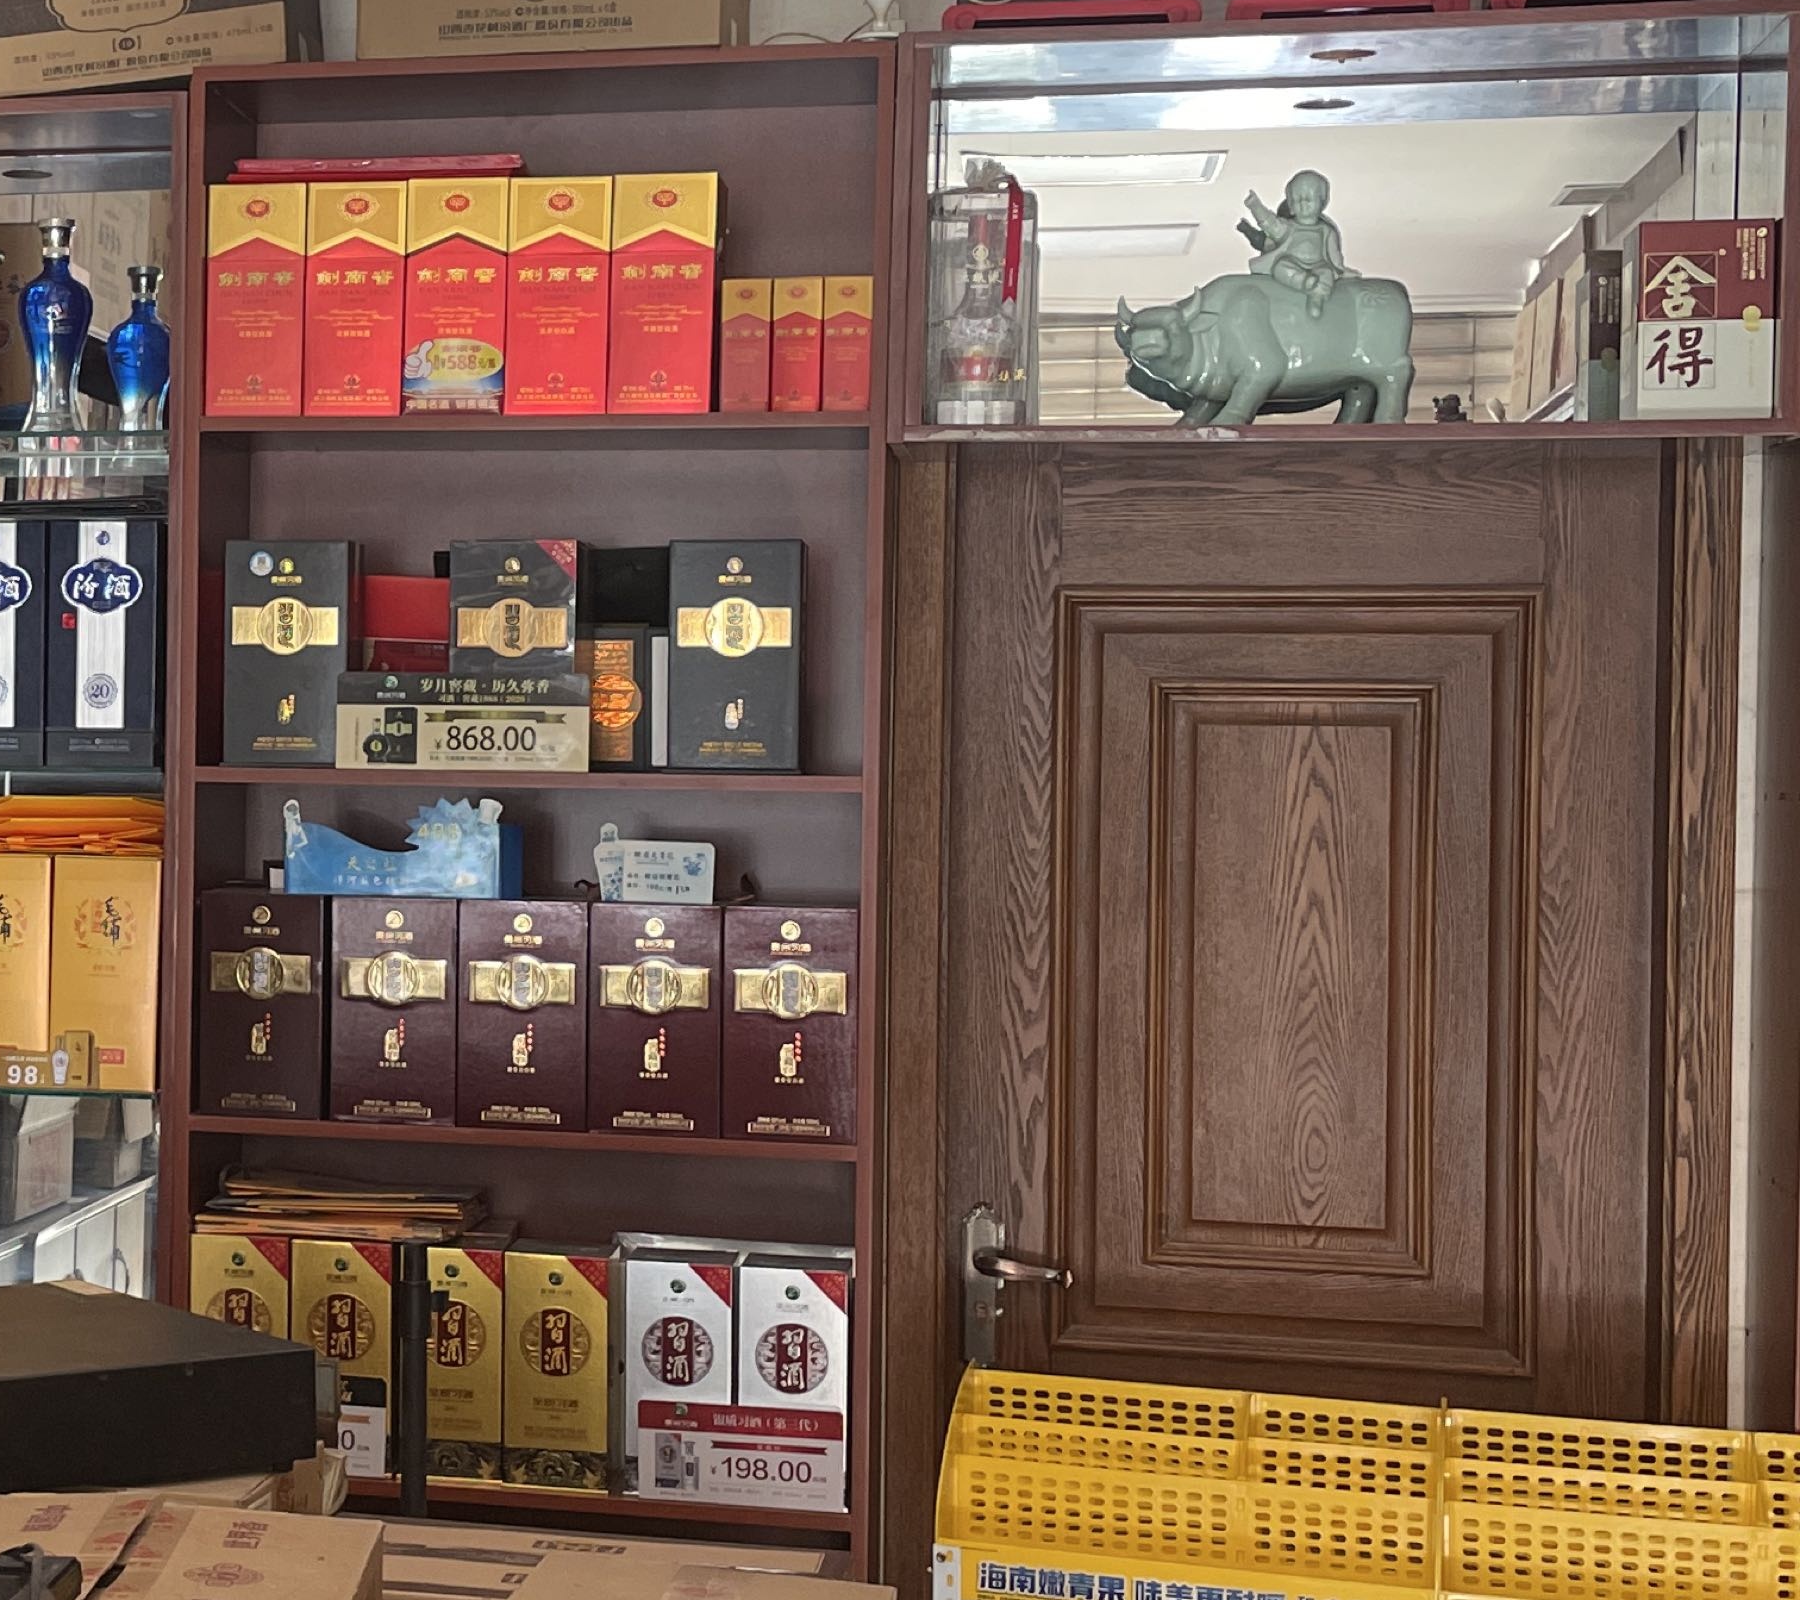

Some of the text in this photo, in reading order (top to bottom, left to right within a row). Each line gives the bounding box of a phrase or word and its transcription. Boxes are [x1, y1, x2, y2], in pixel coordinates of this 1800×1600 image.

[447, 355, 477, 370] 588
[73, 573, 131, 599] 汾酒
[89, 683, 111, 699] 20
[446, 725, 537, 752] 868.00
[7, 1064, 38, 1085] 98
[720, 1456, 812, 1484] 198.00
